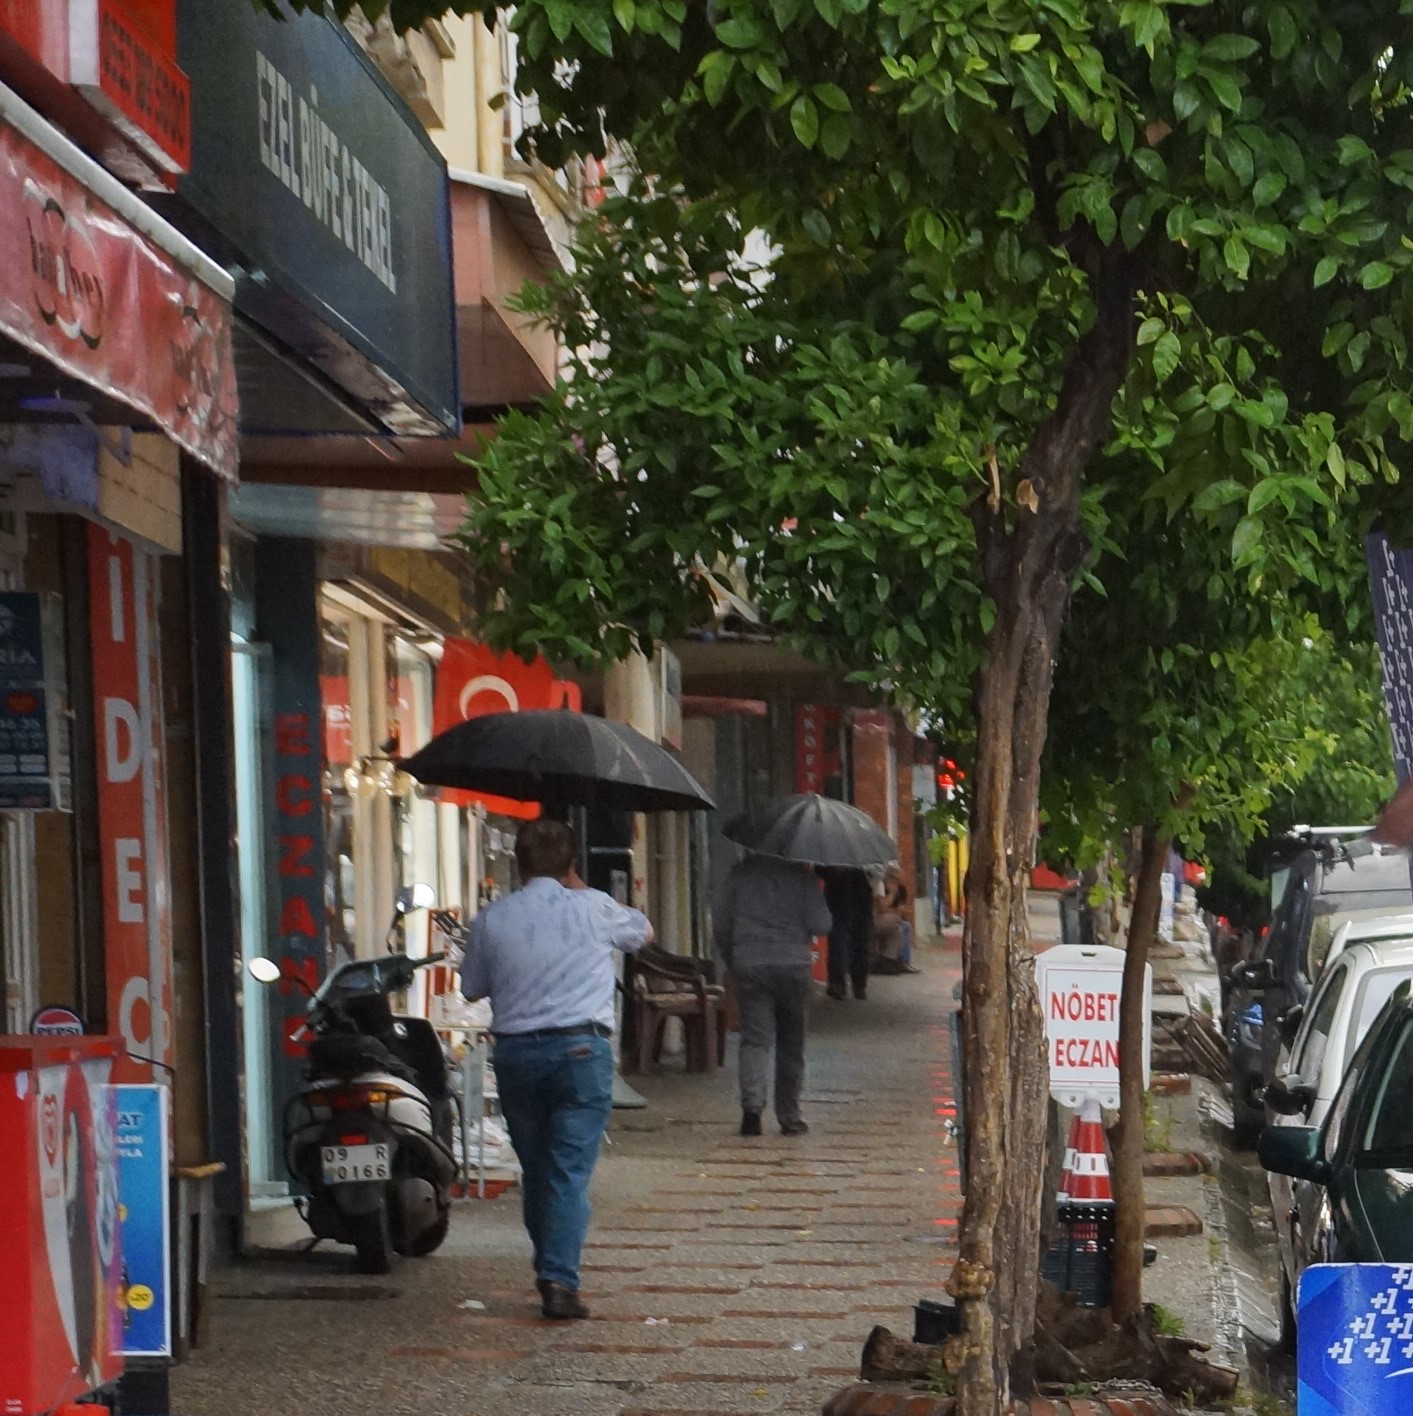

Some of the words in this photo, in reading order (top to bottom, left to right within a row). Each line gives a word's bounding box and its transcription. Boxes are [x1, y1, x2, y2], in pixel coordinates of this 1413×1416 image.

[299, 83, 342, 240] BÜFE
[352, 155, 397, 296] TEKEL
[1051, 983, 1118, 1022] NÖBET
[325, 1147, 348, 1163] 09
[376, 1145, 387, 1160] R
[338, 1163, 387, 1180] 0166
